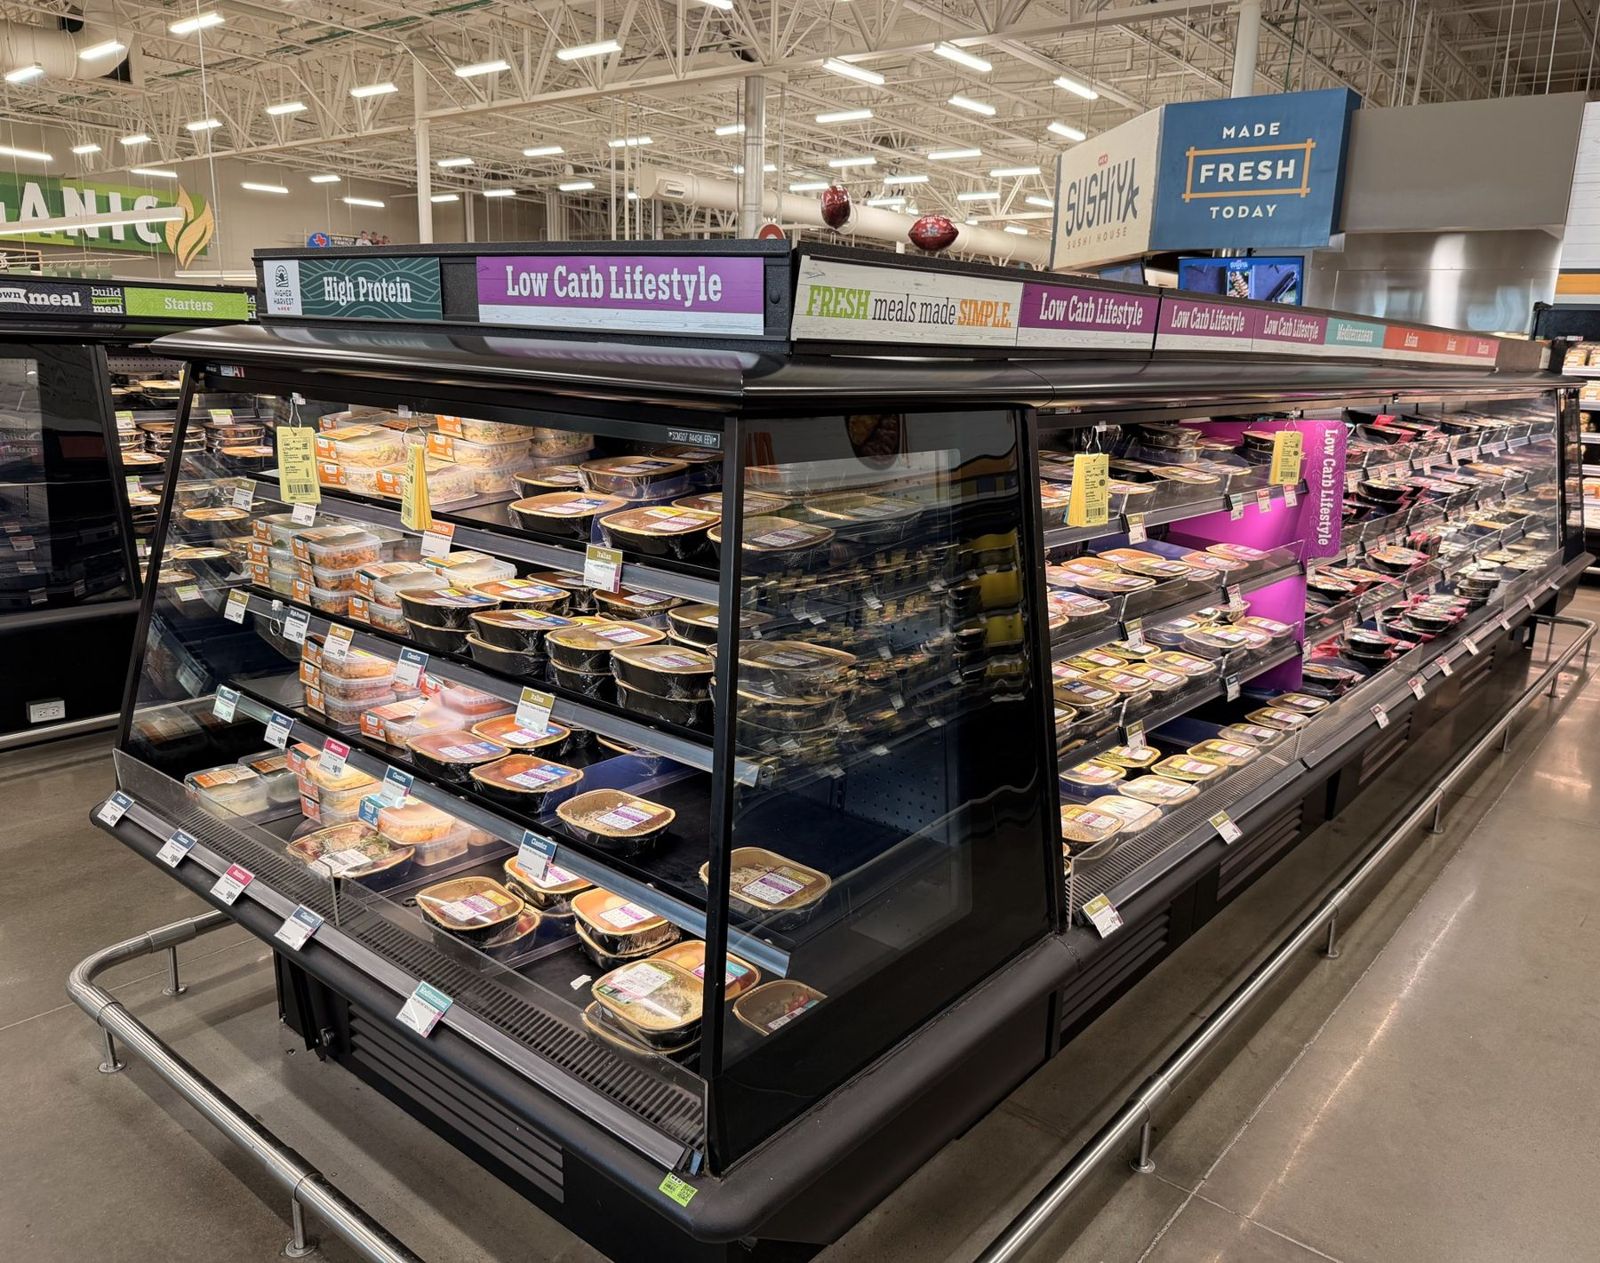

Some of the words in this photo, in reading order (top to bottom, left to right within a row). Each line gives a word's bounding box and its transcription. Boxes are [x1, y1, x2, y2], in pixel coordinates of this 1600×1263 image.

[1222, 122, 1281, 139] MADE
[1199, 159, 1296, 184] FRESH
[1209, 204, 1278, 220] TODAY
[1097, 226, 1128, 241] HOUSE
[91, 286, 122, 297] build
[322, 276, 356, 306] High
[358, 276, 412, 303] Protein
[505, 265, 548, 298] Low
[554, 265, 604, 299] Carb
[609, 265, 722, 308] Lifestyle
[27, 292, 82, 307] meal
[93, 305, 123, 314] meal
[164, 296, 214, 313] Starters
[806, 285, 871, 320] FRESH
[871, 293, 917, 323] meals
[919, 297, 957, 325] made
[957, 298, 1012, 328] SIMPLE.
[1039, 292, 1067, 322] Low
[1068, 294, 1095, 324] Carb
[1095, 296, 1145, 330] Lifestyle
[1170, 305, 1190, 329] Low
[1189, 306, 1208, 331] Carb
[1208, 309, 1246, 336] Lifestyle
[1263, 315, 1278, 335] Low
[1277, 316, 1292, 338] Carb
[1291, 318, 1319, 342] Lifestyle
[1336, 323, 1373, 344] Mediterranean
[1324, 429, 1338, 455] Low
[1321, 460, 1336, 488] Carb
[1317, 490, 1335, 546] Lifestyle
